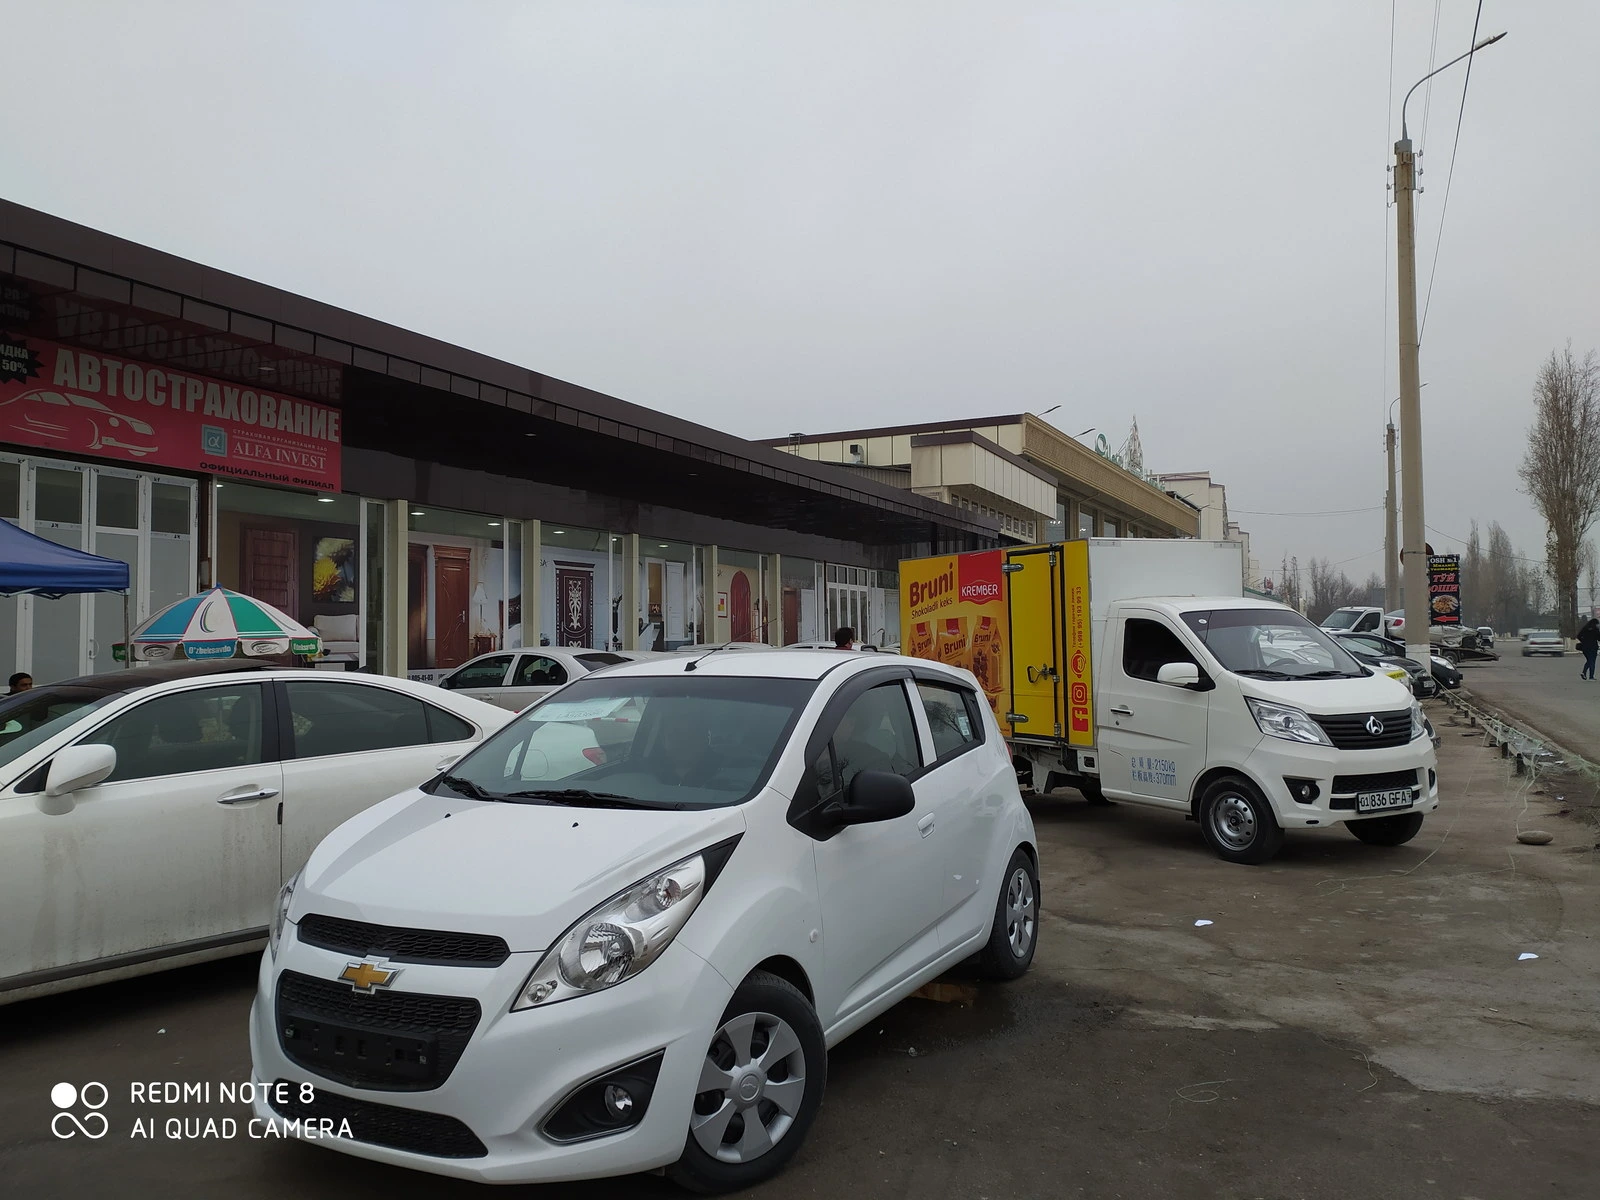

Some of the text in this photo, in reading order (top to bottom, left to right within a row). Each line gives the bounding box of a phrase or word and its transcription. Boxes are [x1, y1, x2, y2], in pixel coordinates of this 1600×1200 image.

[2, 359, 27, 374] 50%
[54, 348, 340, 443] АВТОСТРАХОВАНИЕ
[234, 441, 326, 470] ALFA INVEST
[200, 462, 335, 490] ОФИЦИАЛЬНЫЙ ФИЛИАЛ
[910, 562, 953, 608] Bruni
[961, 584, 998, 597] KREMBER
[912, 597, 952, 619] Shokoladli keks
[917, 634, 932, 652] Bruni
[944, 634, 966, 654] Bruni
[974, 631, 992, 643] Bruni
[1370, 793, 1387, 807] 836
[1388, 791, 1407, 805] GFA
